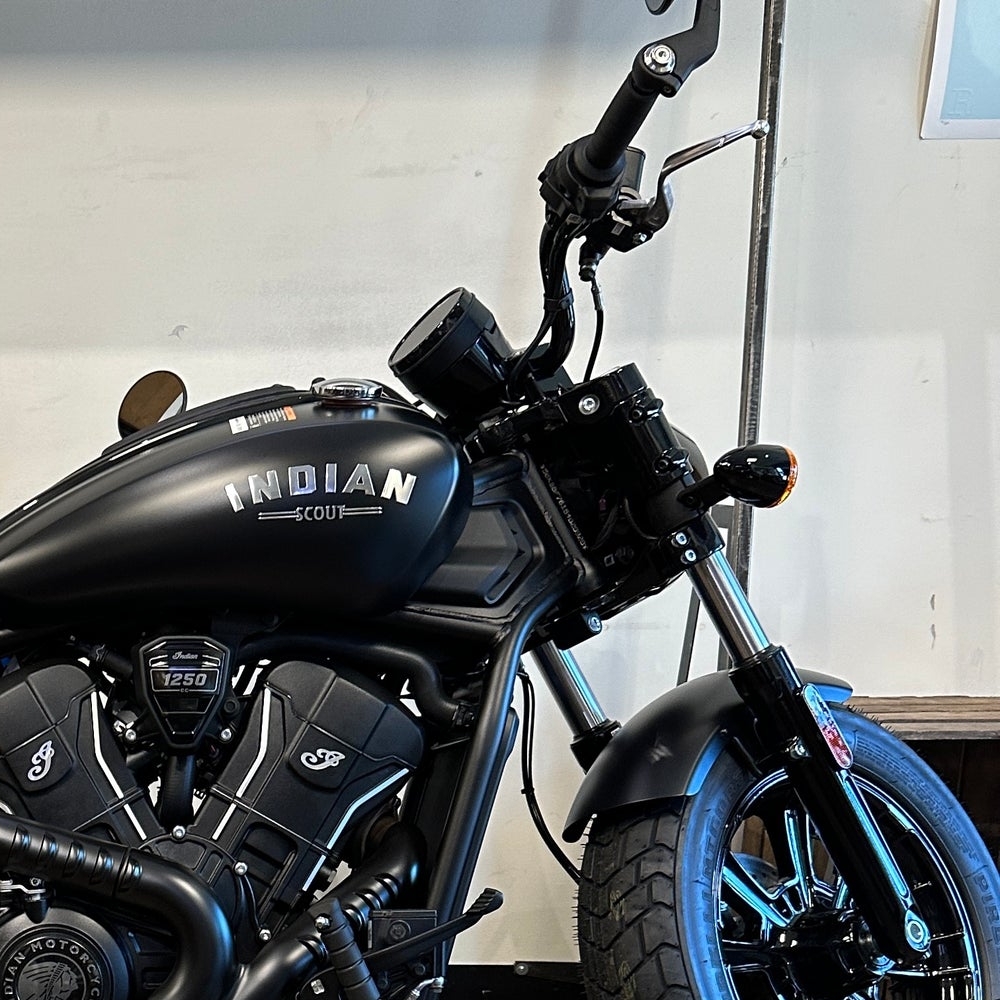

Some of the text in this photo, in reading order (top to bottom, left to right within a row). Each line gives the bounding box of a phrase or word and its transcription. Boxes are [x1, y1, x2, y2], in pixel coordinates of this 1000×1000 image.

[224, 463, 417, 513] INDIAN
[295, 505, 346, 522] SCOUT
[172, 651, 198, 660] Indian
[164, 673, 208, 687] 1250
